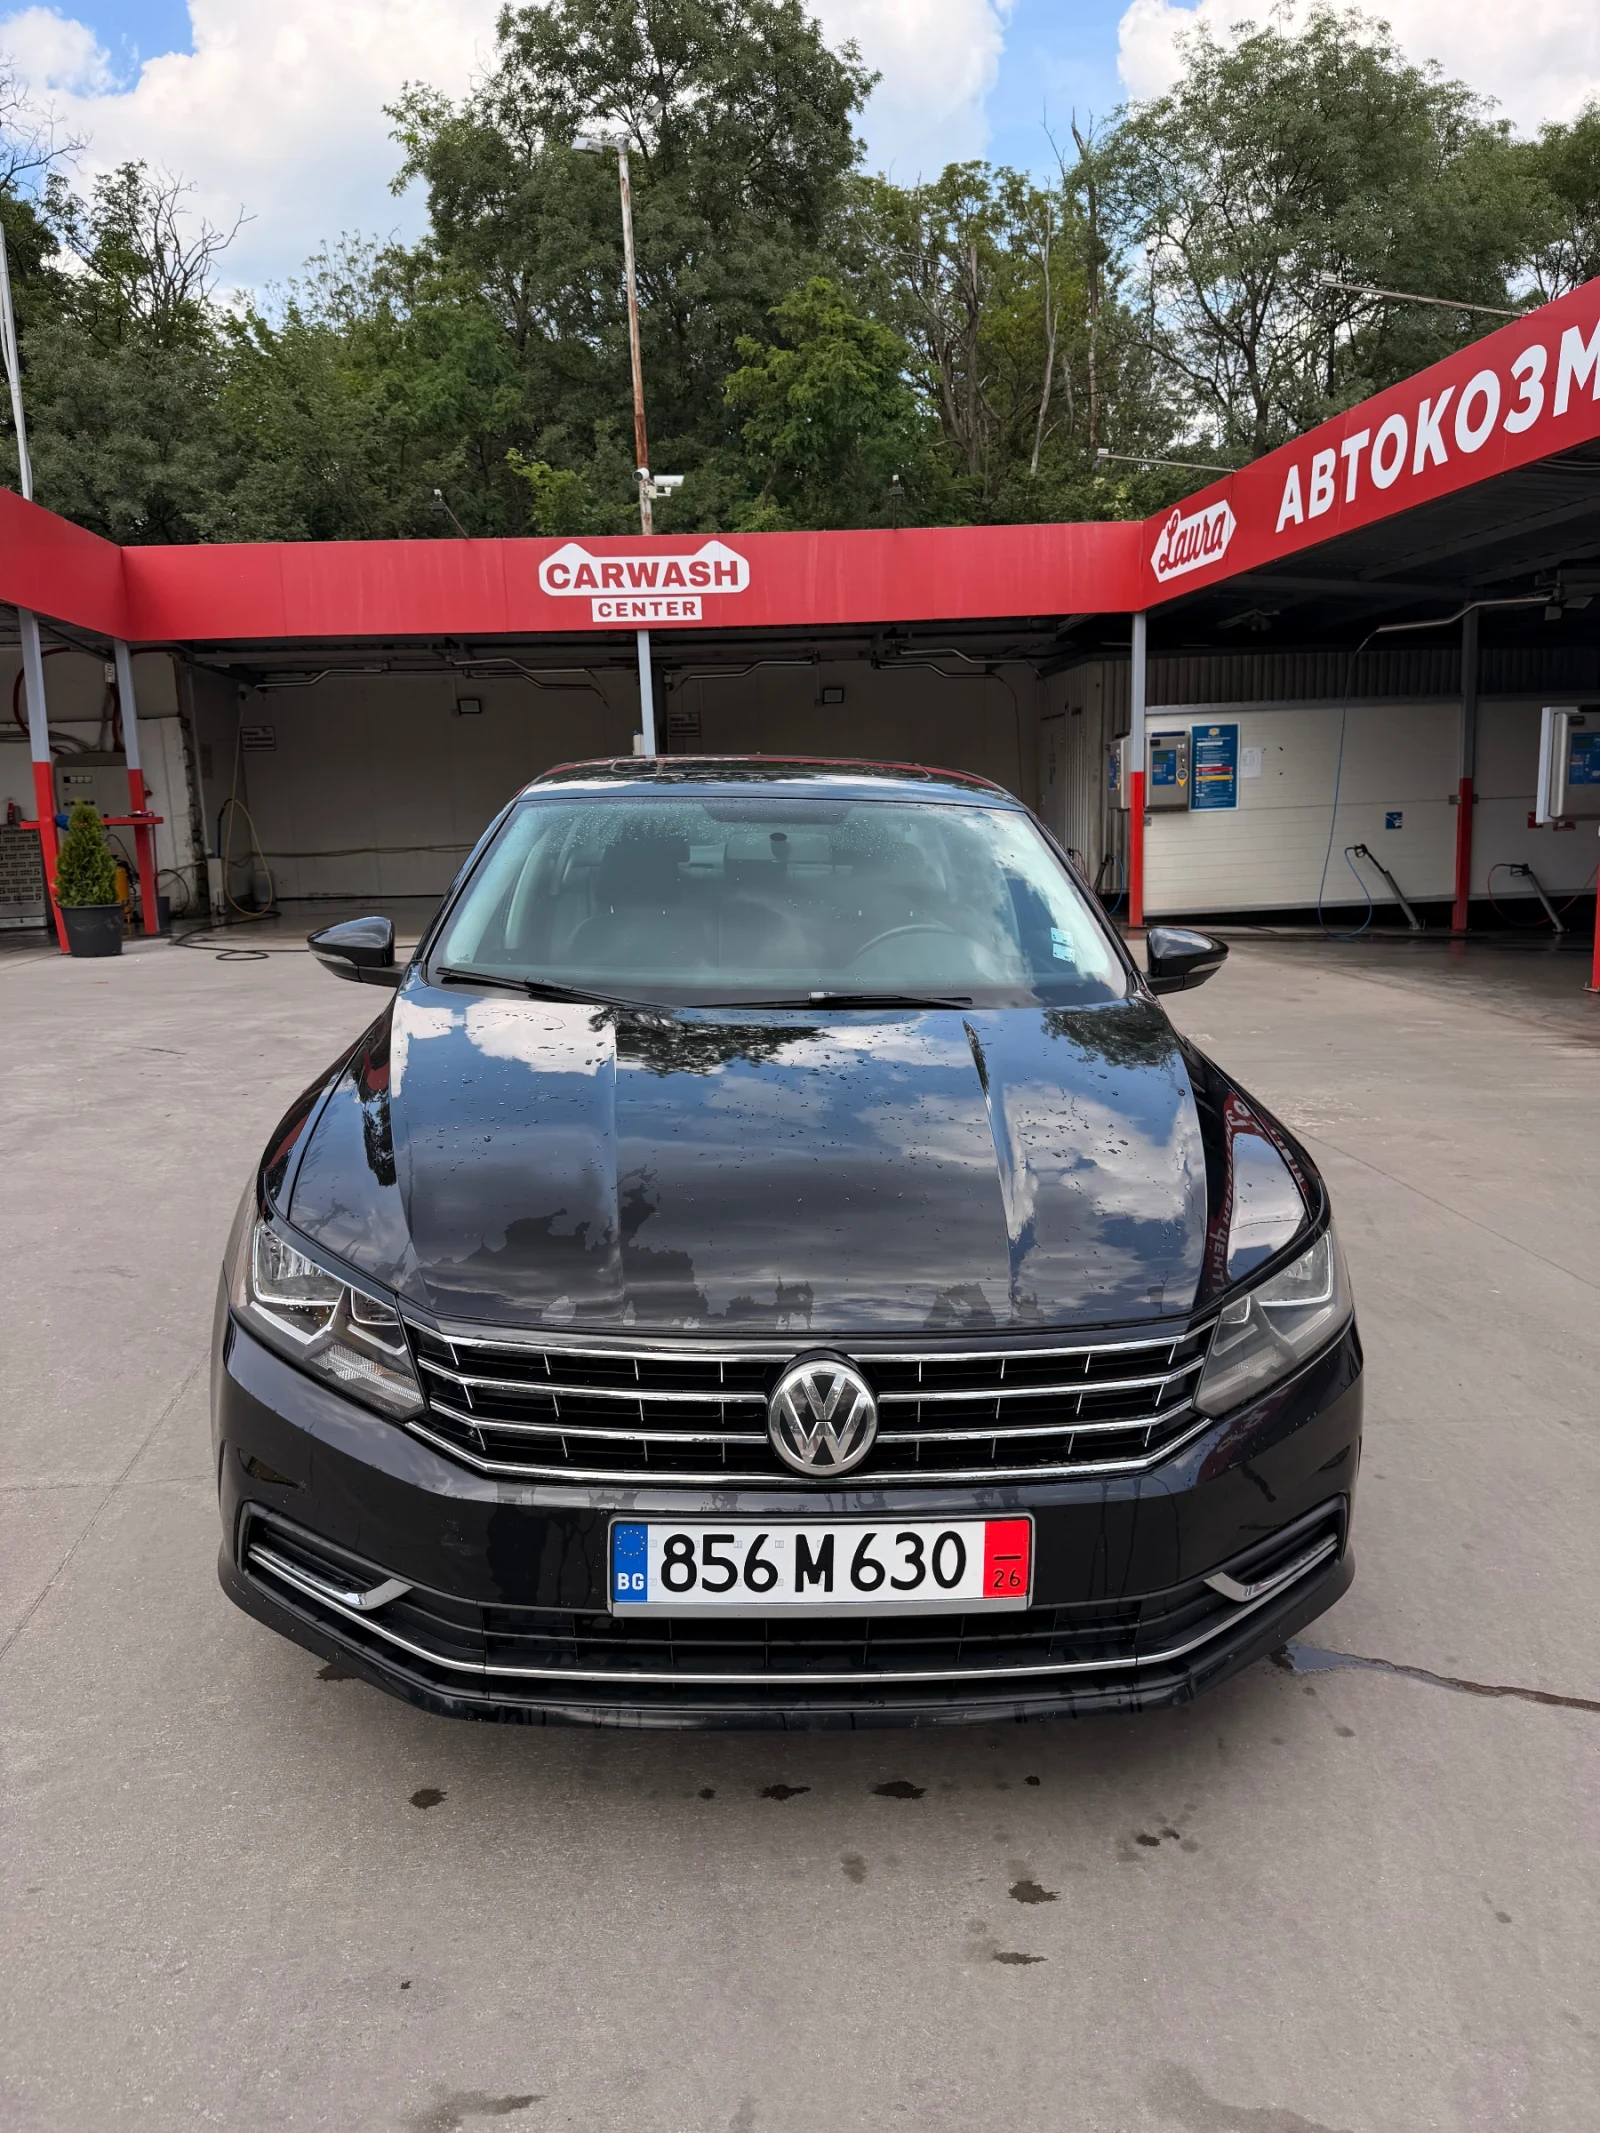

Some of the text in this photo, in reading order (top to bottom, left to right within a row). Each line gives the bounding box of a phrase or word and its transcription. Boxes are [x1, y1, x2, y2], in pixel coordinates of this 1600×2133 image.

[1158, 510, 1226, 574] Laura
[546, 560, 739, 590] CARWASH
[597, 600, 696, 618] CENTER
[660, 1530, 967, 1593] 856 M 630
[617, 1572, 645, 1591] BG
[993, 1569, 1021, 1588] 26
